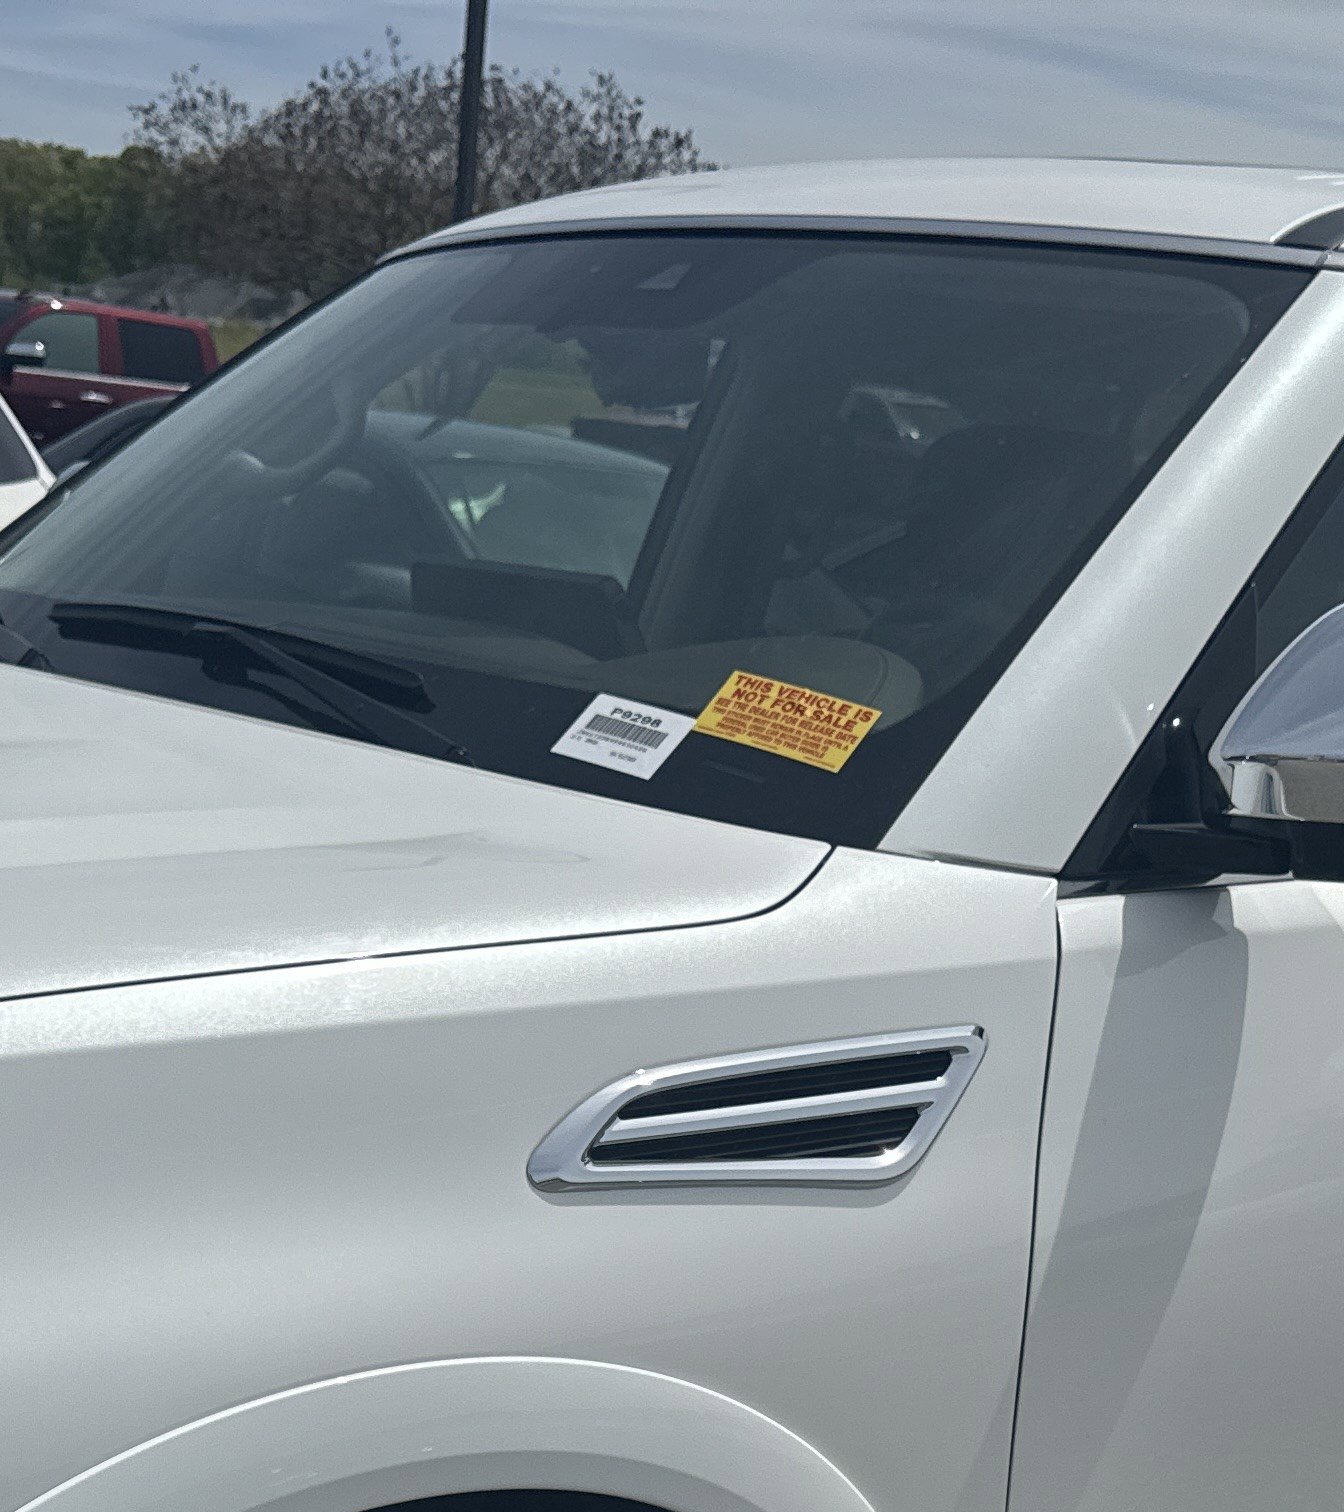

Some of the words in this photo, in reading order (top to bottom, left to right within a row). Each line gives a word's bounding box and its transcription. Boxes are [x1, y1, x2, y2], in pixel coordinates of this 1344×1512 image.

[731, 688, 769, 705] NOT
[770, 698, 807, 717] FOR
[809, 709, 858, 732] SALE
[735, 675, 774, 694] THIS
[777, 685, 852, 716] VEHICLE
[853, 709, 873, 722] IS
[748, 705, 781, 720] DEALER
[780, 714, 799, 726] FOR
[798, 720, 836, 737] RELEASE
[835, 731, 859, 744] DATE
